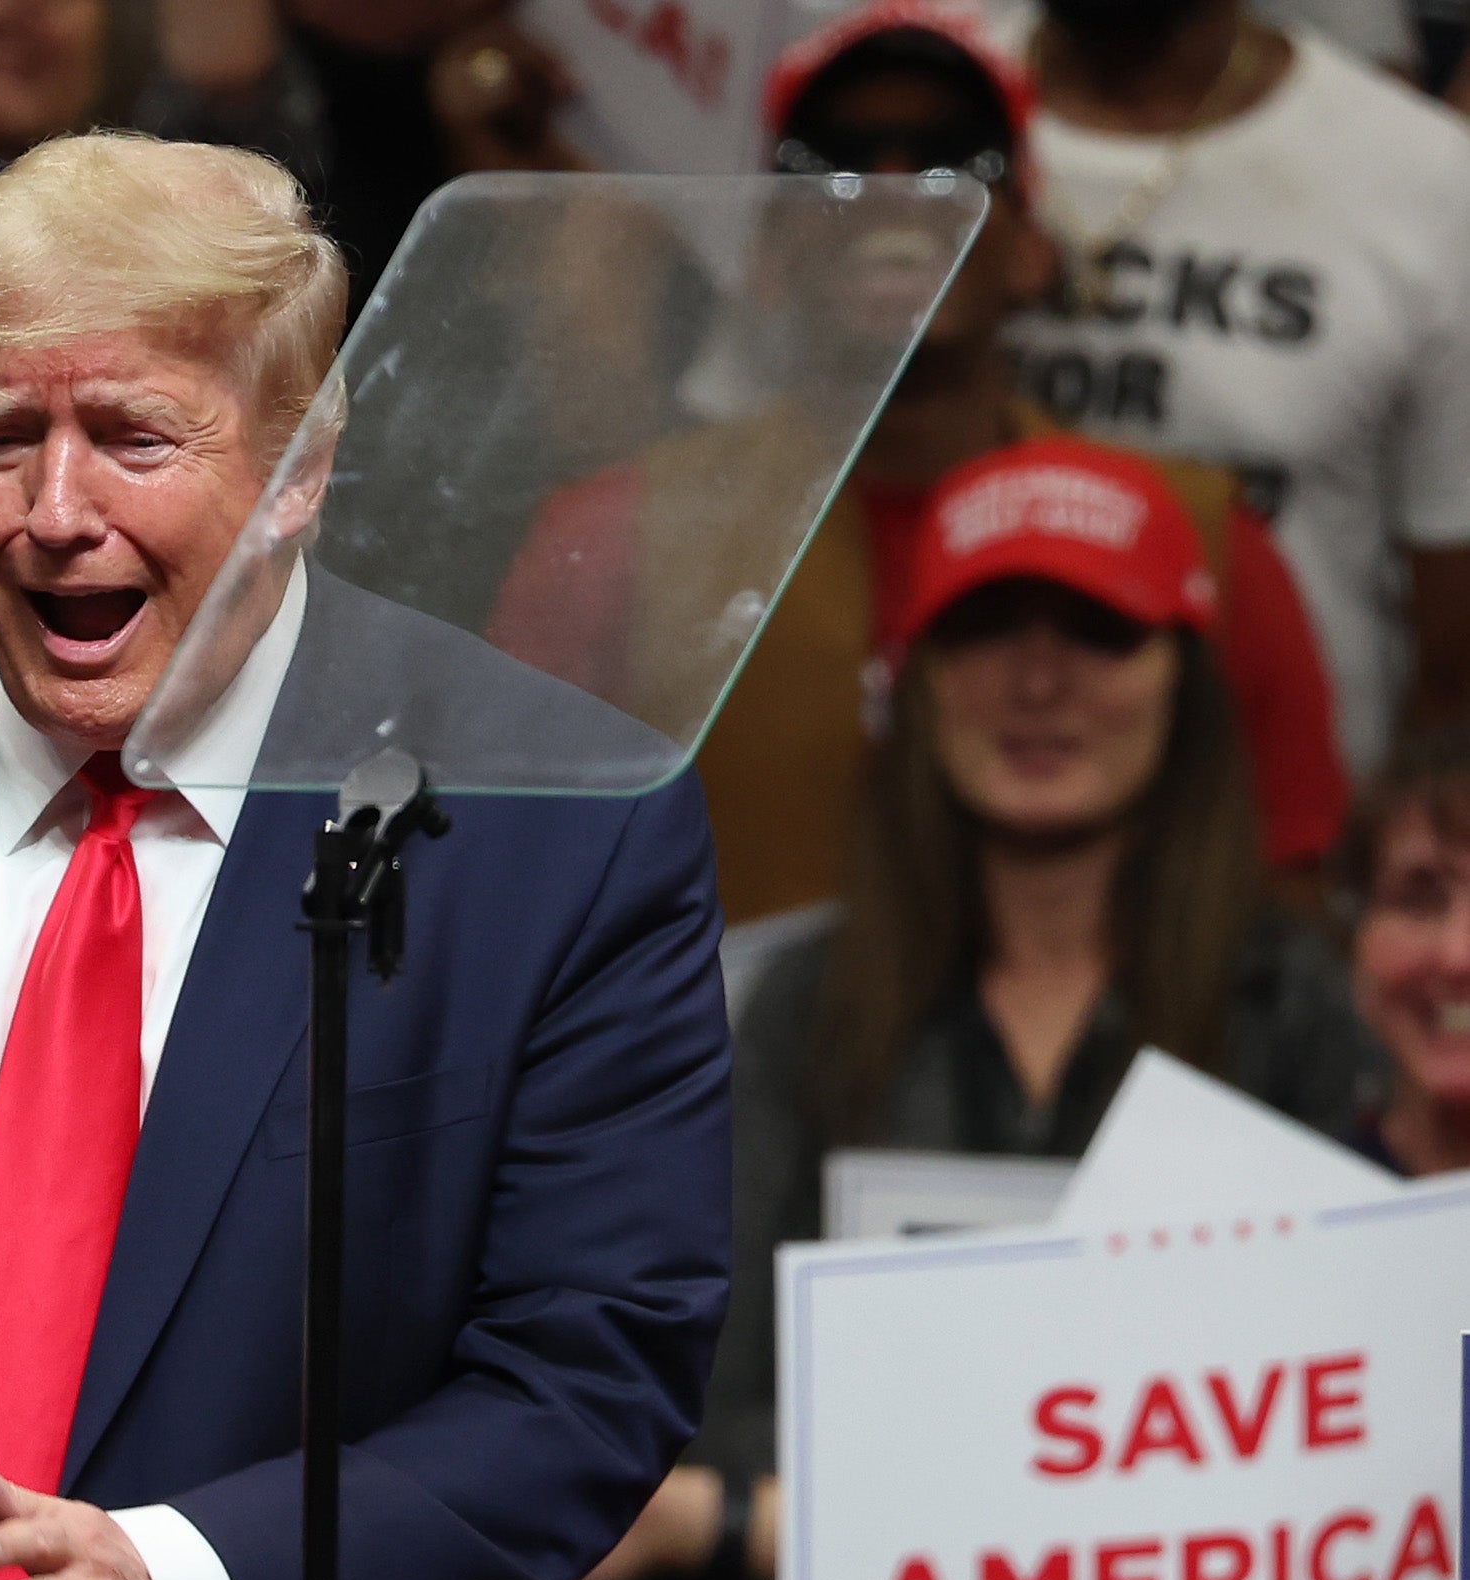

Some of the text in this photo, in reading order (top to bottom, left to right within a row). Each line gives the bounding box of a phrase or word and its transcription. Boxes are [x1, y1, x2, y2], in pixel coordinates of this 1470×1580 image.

[1049, 240, 1317, 344] CKS
[1014, 346, 1167, 430] OR
[1029, 1348, 1369, 1478] SAVE
